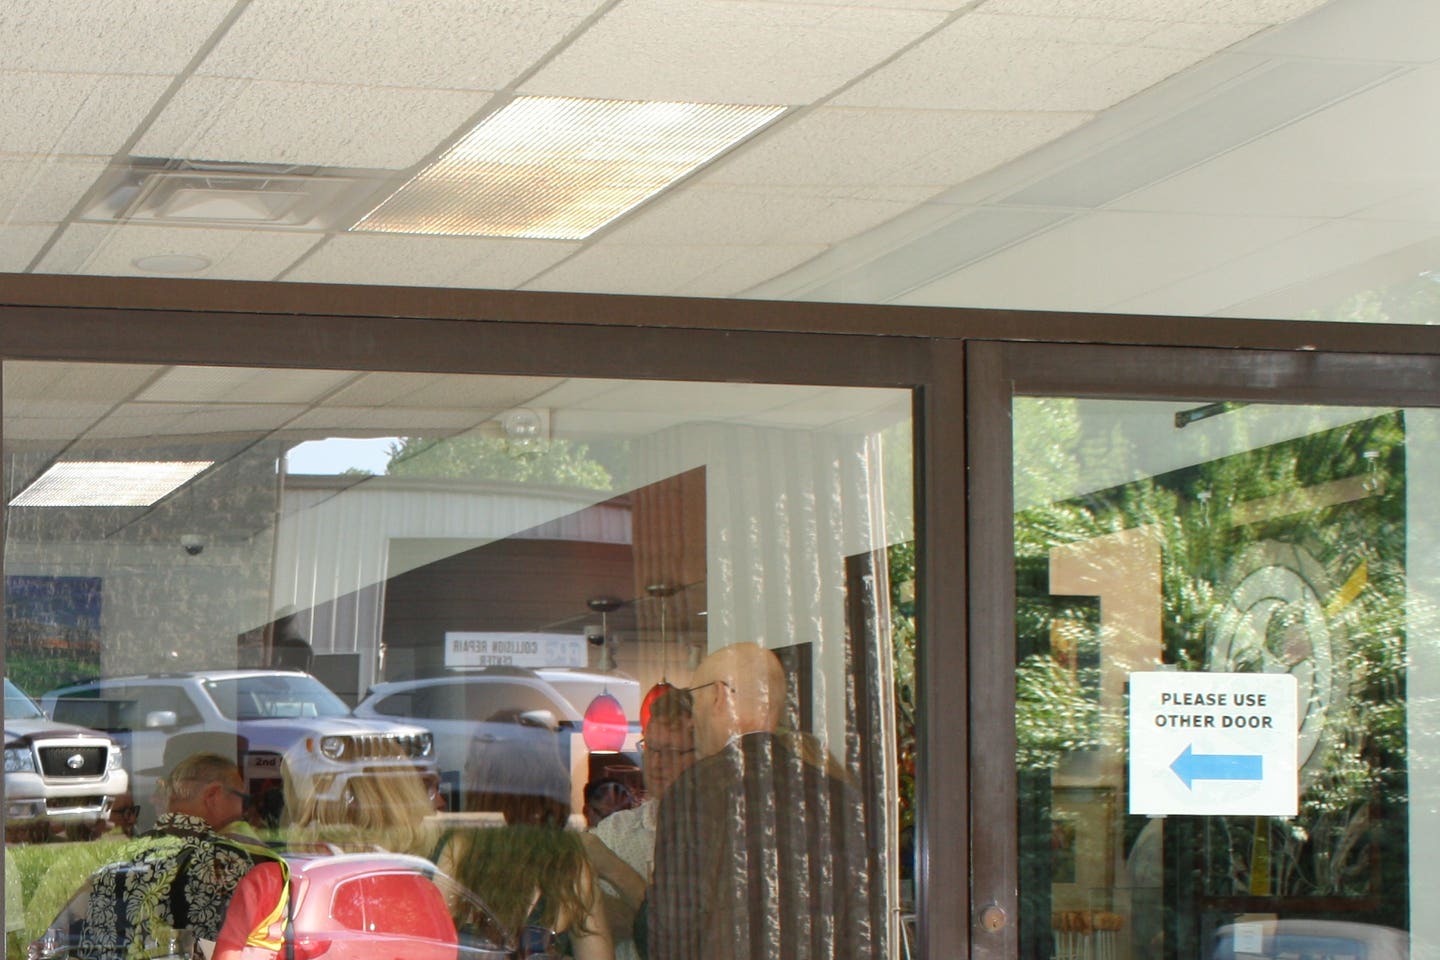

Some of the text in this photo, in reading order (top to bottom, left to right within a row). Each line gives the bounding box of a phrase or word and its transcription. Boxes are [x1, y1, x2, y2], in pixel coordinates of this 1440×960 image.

[1161, 692, 1267, 707] PLEASE USE
[1155, 714, 1273, 729] OTHER DOOR
